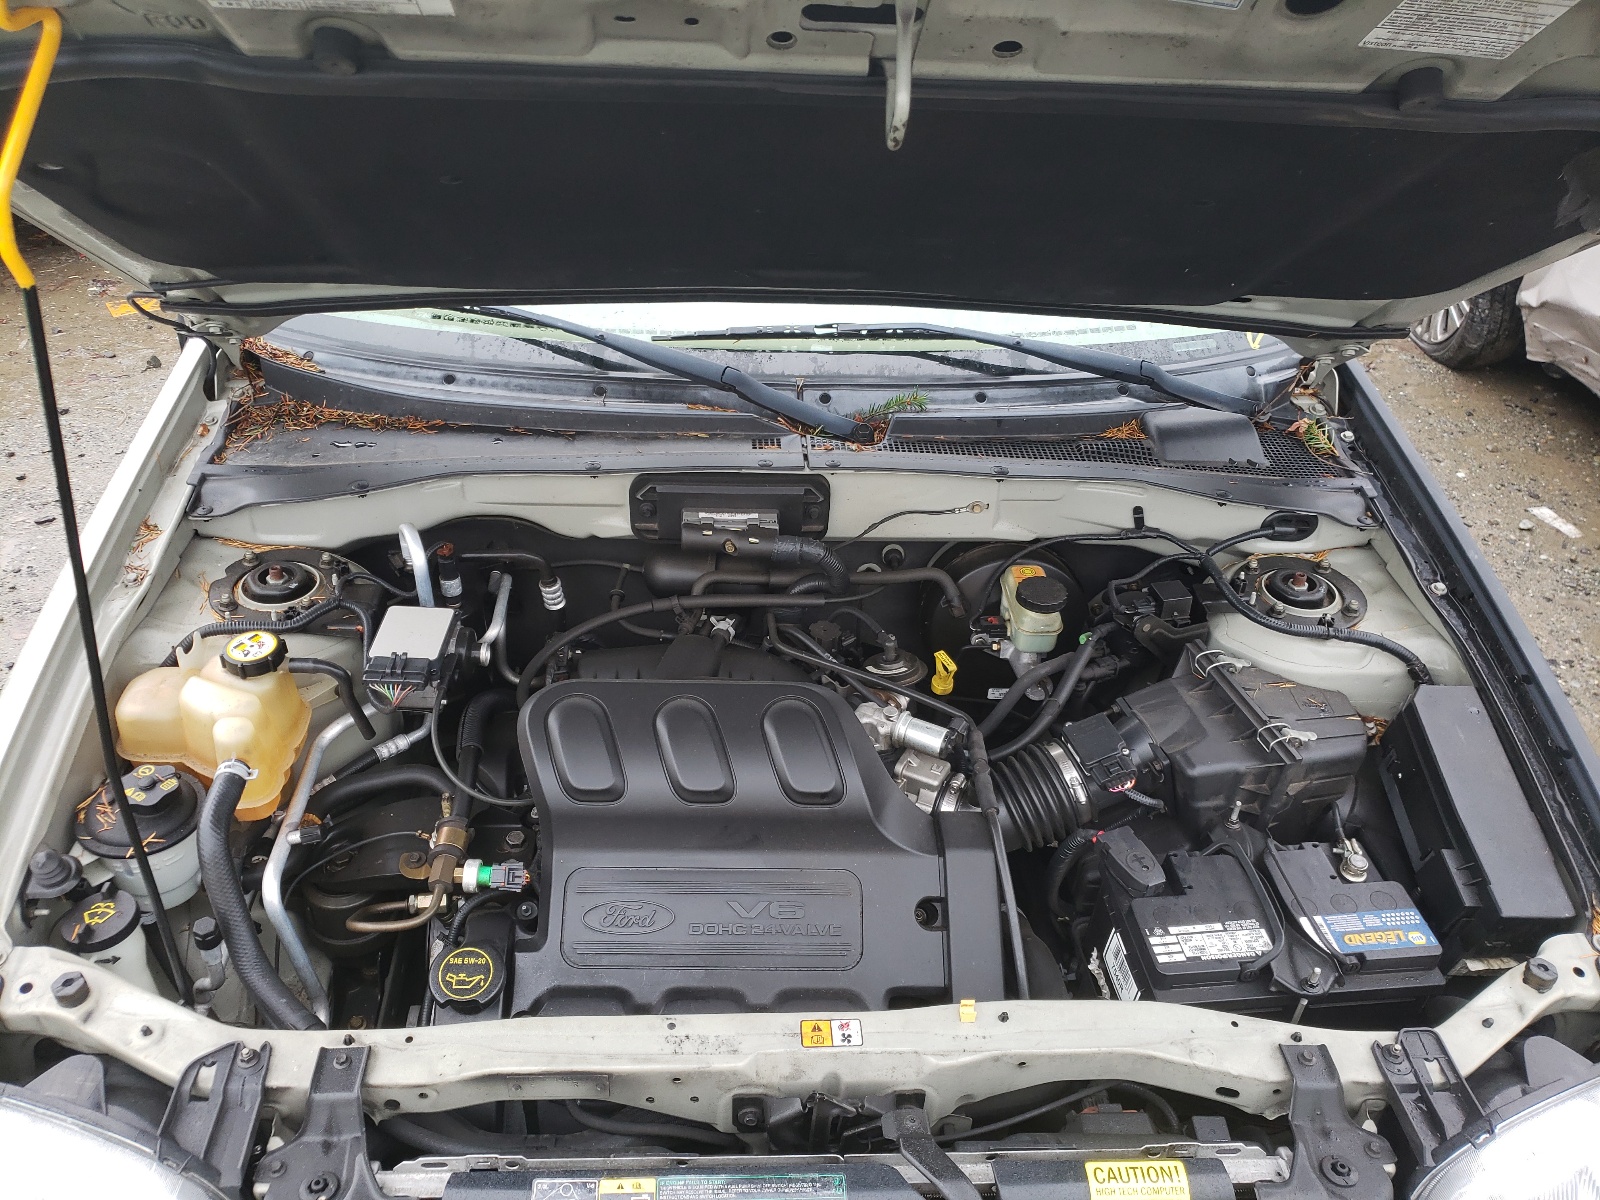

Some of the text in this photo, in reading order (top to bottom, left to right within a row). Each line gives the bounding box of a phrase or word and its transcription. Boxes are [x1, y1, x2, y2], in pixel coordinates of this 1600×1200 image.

[599, 904, 657, 929] Ford
[726, 900, 806, 920] V6
[688, 922, 748, 936] DOHC
[1343, 930, 1406, 946] LEGEND
[449, 957, 463, 965] SAE
[1093, 1165, 1181, 1184] CAUTION!
[1096, 1186, 1185, 1196] HIGH TECH COMPUTER
